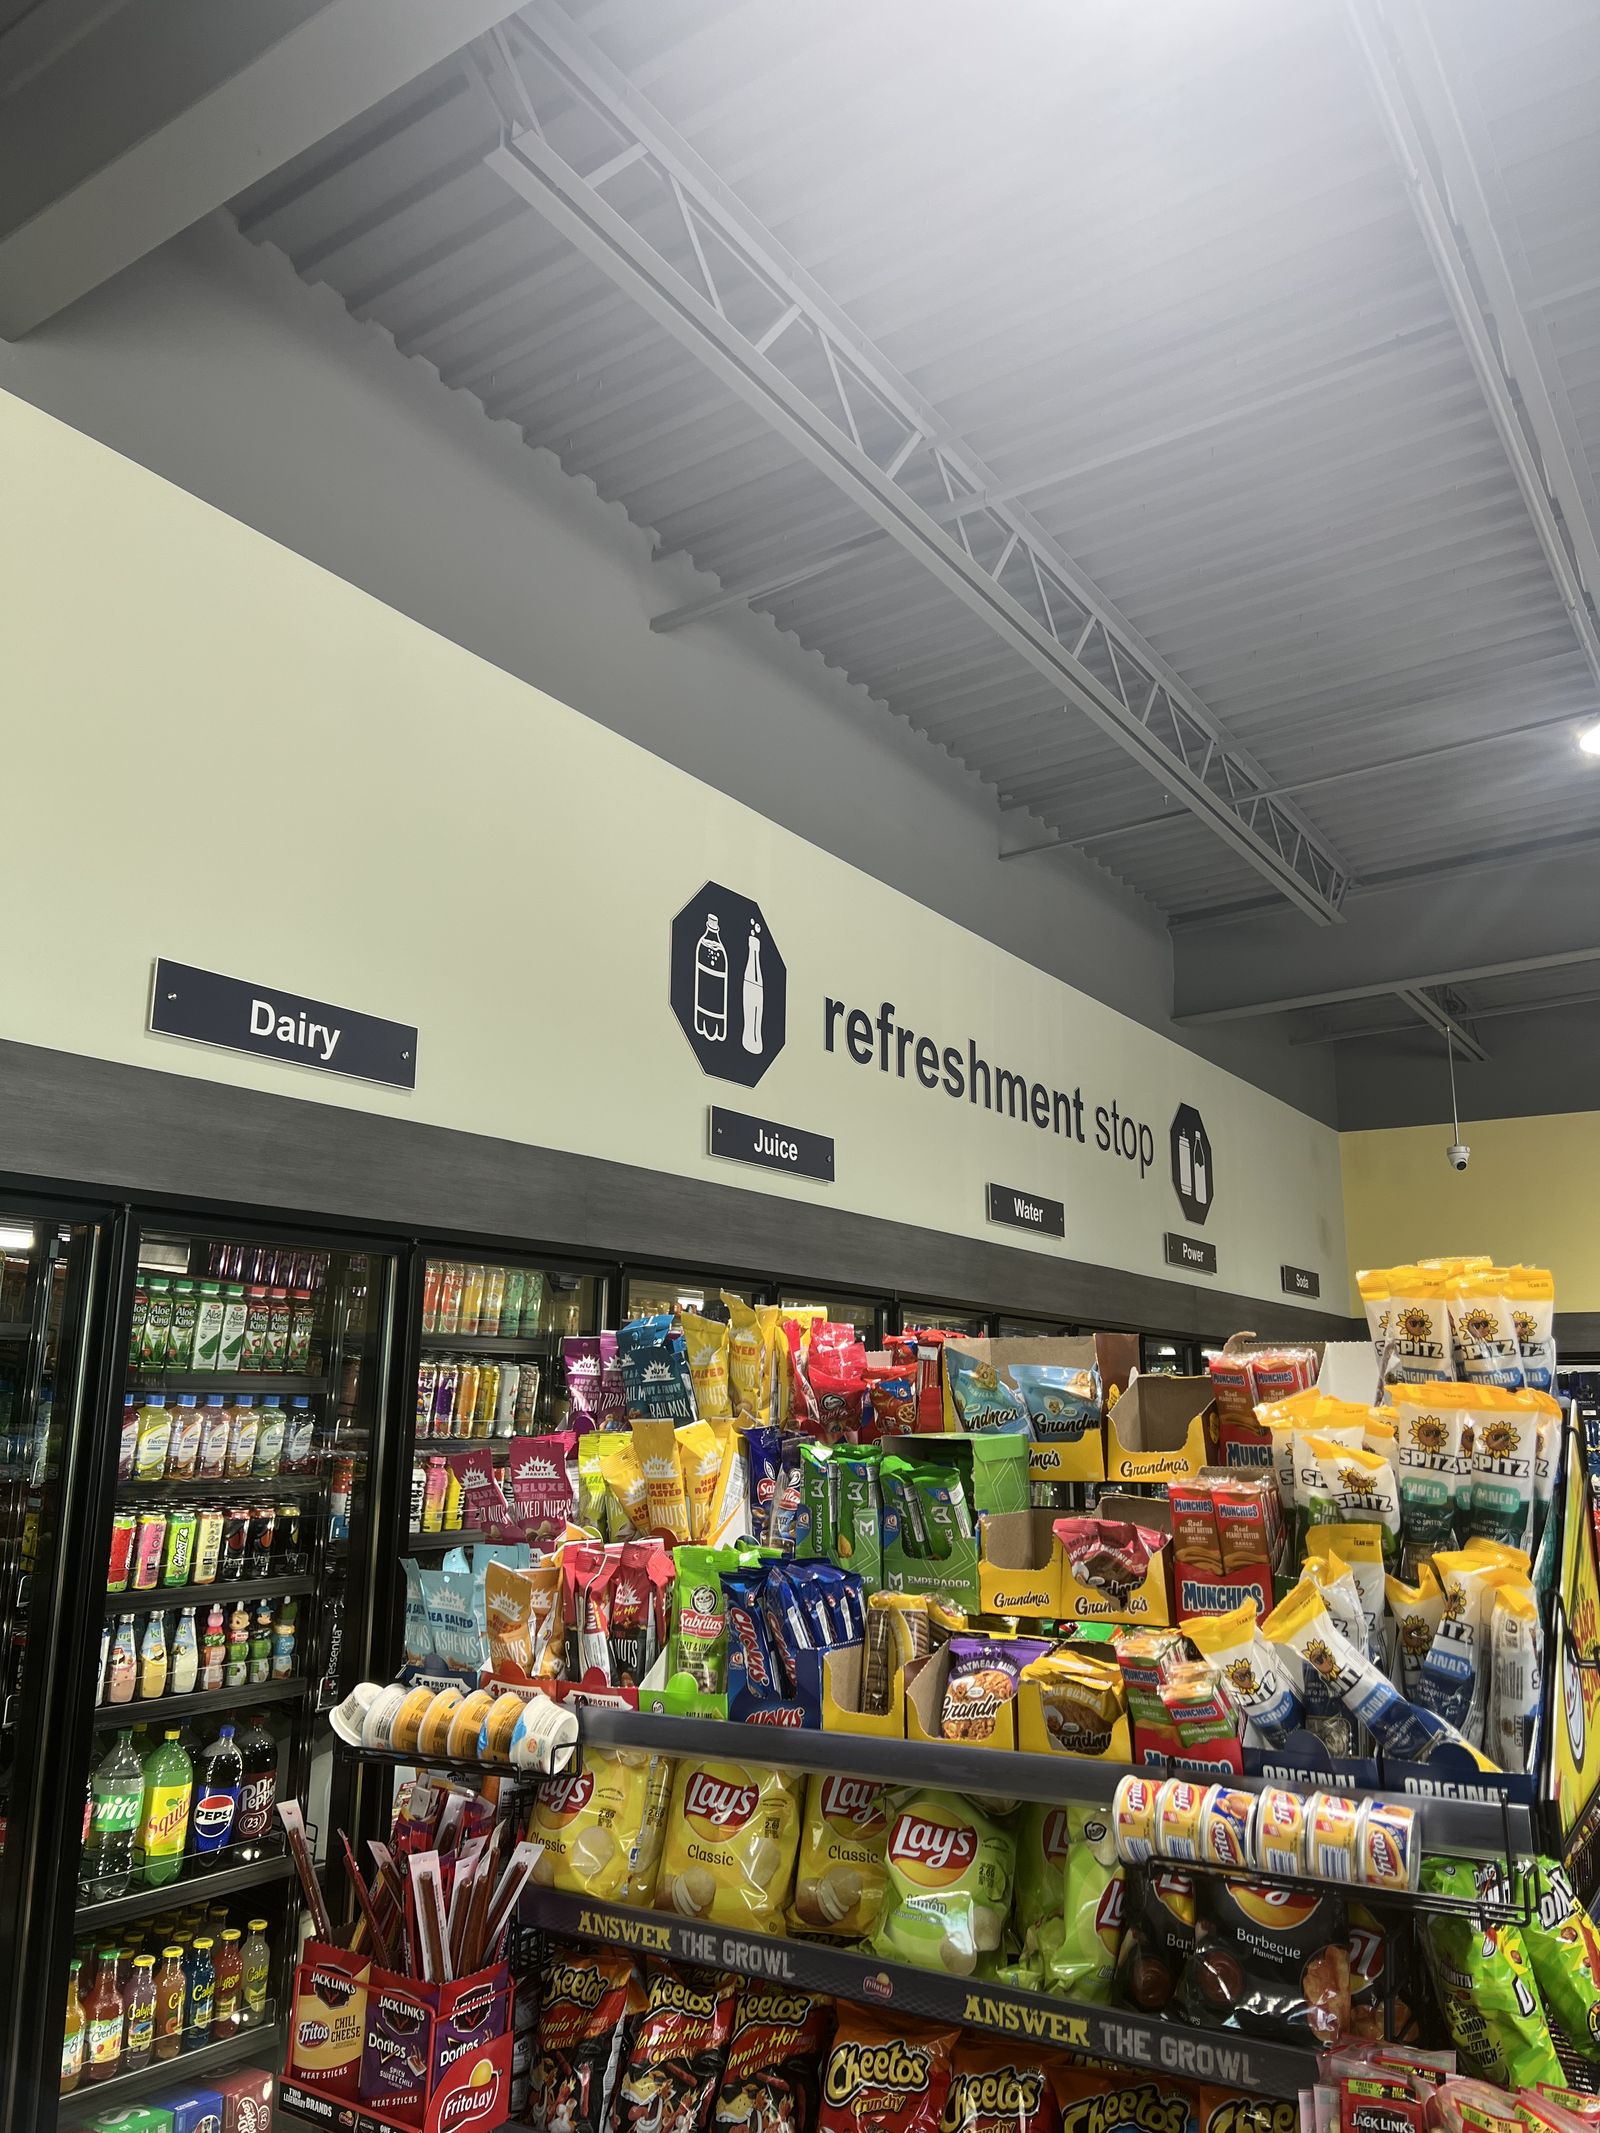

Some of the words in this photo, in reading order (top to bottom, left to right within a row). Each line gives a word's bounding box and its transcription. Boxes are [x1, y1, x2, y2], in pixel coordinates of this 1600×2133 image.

[250, 999, 341, 1060] Dairy
[824, 996, 1086, 1144] refreshment
[1095, 1100, 1154, 1179] stop
[753, 1128, 798, 1161] Juice
[1013, 1197, 1043, 1224] Water
[1182, 1243, 1204, 1263] Power
[1295, 1273, 1309, 1289] Soda
[134, 1304, 147, 1313] loe
[152, 1305, 170, 1315] Aloe
[176, 1306, 194, 1316] Aloe
[150, 1315, 170, 1326] King
[174, 1316, 194, 1327] King
[271, 1313, 289, 1323] Aloe
[270, 1322, 289, 1333] King
[1213, 1372, 1245, 1386] MUNCHIES
[1256, 1370, 1293, 1384] MUNCHIES
[528, 1464, 548, 1472] NUT
[1120, 1457, 1190, 1477] Grandma's
[513, 1482, 565, 1492] DELUXE
[649, 1482, 675, 1490] ONEY
[650, 1488, 682, 1497] ASTED
[1174, 1499, 1213, 1513] MUNCHIES
[1219, 1503, 1259, 1518] MUNCHIES
[994, 1591, 1050, 1608] Grandma's
[445, 1613, 473, 1629] SALTED
[680, 1612, 723, 1630] Sabritas
[330, 1629, 342, 1675] essentia
[435, 1631, 479, 1659] ASHEWS
[431, 1679, 460, 1689] PROTEIN
[1123, 1667, 1160, 1685] MUNCHIES
[1172, 1705, 1217, 1720] MUNCHIES
[259, 1776, 273, 1793] Dr
[687, 1774, 758, 1825] Lay's
[196, 1808, 232, 1821] PEPSI
[248, 1819, 259, 1829] 23
[892, 1816, 974, 1868] Lay's
[1211, 1821, 1236, 1865] Fritos
[687, 1844, 734, 1866] Classic
[828, 1845, 879, 1864] Classic
[1374, 1831, 1397, 1878] Fritos
[577, 1910, 672, 1951] ANSWER
[679, 1929, 717, 1961] THE
[722, 1940, 796, 1979] GROWL
[1236, 1927, 1301, 1960] Barbecue
[1252, 1946, 1283, 1964] Flavored
[310, 1972, 331, 1988] JACK
[378, 1995, 400, 2013] JACK
[650, 1975, 715, 2019] heetos
[334, 2014, 356, 2030] CHILI
[735, 1996, 809, 2031] heetos
[299, 2021, 329, 2044] Fritos
[331, 2025, 361, 2043] CHEESE
[681, 2019, 712, 2042] Hot
[769, 2026, 801, 2048] Hot
[963, 1994, 1090, 2048] ANSWER
[1099, 2021, 1151, 2062] THE
[1160, 2035, 1261, 2085] GROWL
[368, 2032, 407, 2059] Doritos
[300, 2070, 321, 2080] MEAT
[323, 2067, 348, 2079] STICKS
[379, 2069, 399, 2083] SWEET
[389, 2066, 405, 2078] SPICY
[827, 2043, 930, 2105] Cheetos
[288, 2087, 301, 2099] TWO
[371, 2098, 390, 2108] MEAT
[392, 2095, 418, 2106] STICKS
[941, 2067, 1041, 2132] Cheetos
[305, 2097, 333, 2118] BRANDS
[851, 2093, 906, 2115] Crunchy
[1063, 2085, 1188, 2133] Cheetos
[1350, 2112, 1379, 2129] JACK
